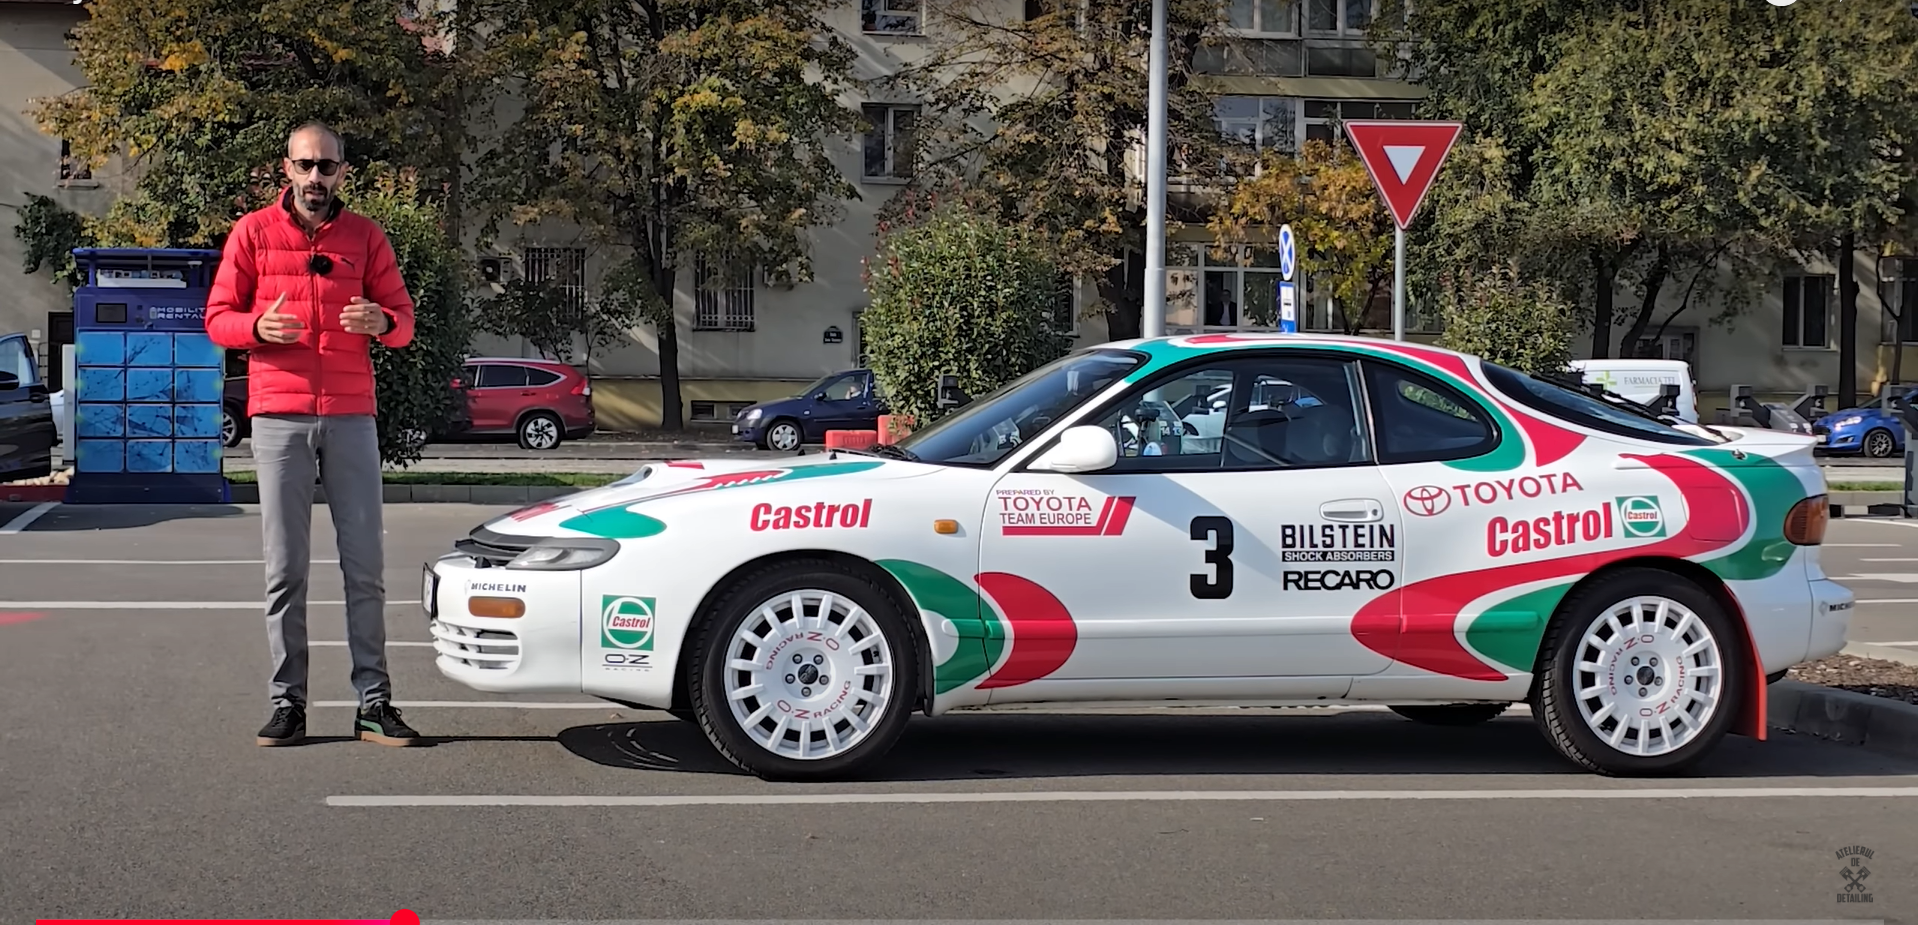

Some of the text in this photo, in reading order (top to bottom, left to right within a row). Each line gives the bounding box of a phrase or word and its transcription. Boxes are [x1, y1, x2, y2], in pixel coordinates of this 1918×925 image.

[1452, 471, 1584, 506] TOYOTA
[750, 498, 872, 531] Castrol
[998, 496, 1092, 511] TOYOTA
[1000, 513, 1092, 524] TEAM EUROPE
[1627, 510, 1658, 521] Castrol
[1281, 524, 1395, 549] BILSTEIN
[1487, 502, 1613, 557] Castrol
[1190, 515, 1234, 600] 3
[1284, 551, 1393, 561] SHOCK ABSORBERS
[470, 583, 527, 592] MICHELIN
[1283, 569, 1395, 591] RECARO
[612, 615, 651, 629] Castrol
[1670, 655, 1685, 704] RACING
[813, 680, 851, 719] RACING
